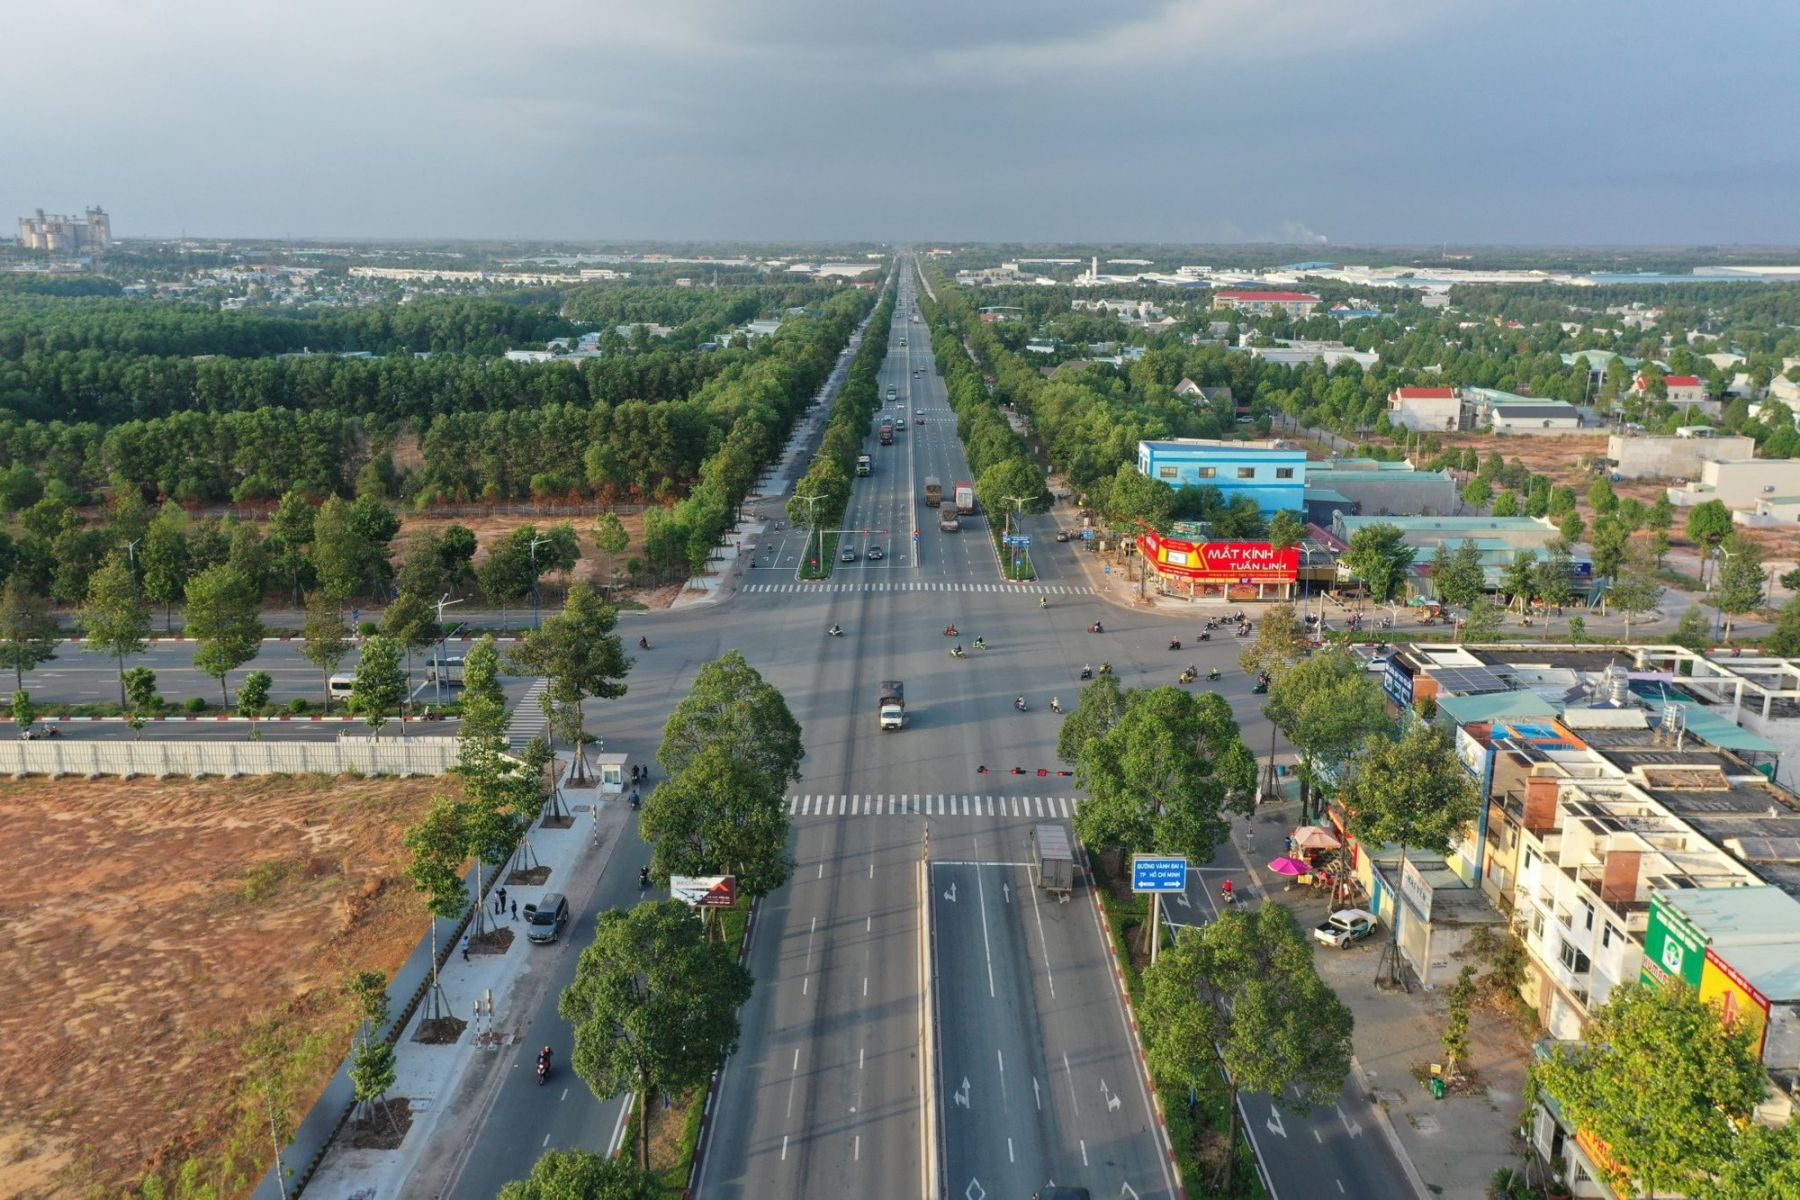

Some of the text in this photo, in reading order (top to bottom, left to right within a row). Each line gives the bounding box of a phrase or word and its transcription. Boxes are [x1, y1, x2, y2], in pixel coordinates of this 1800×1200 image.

[1207, 545, 1274, 559] MẮT KÍNH
[1230, 560, 1260, 570] TUẤN
